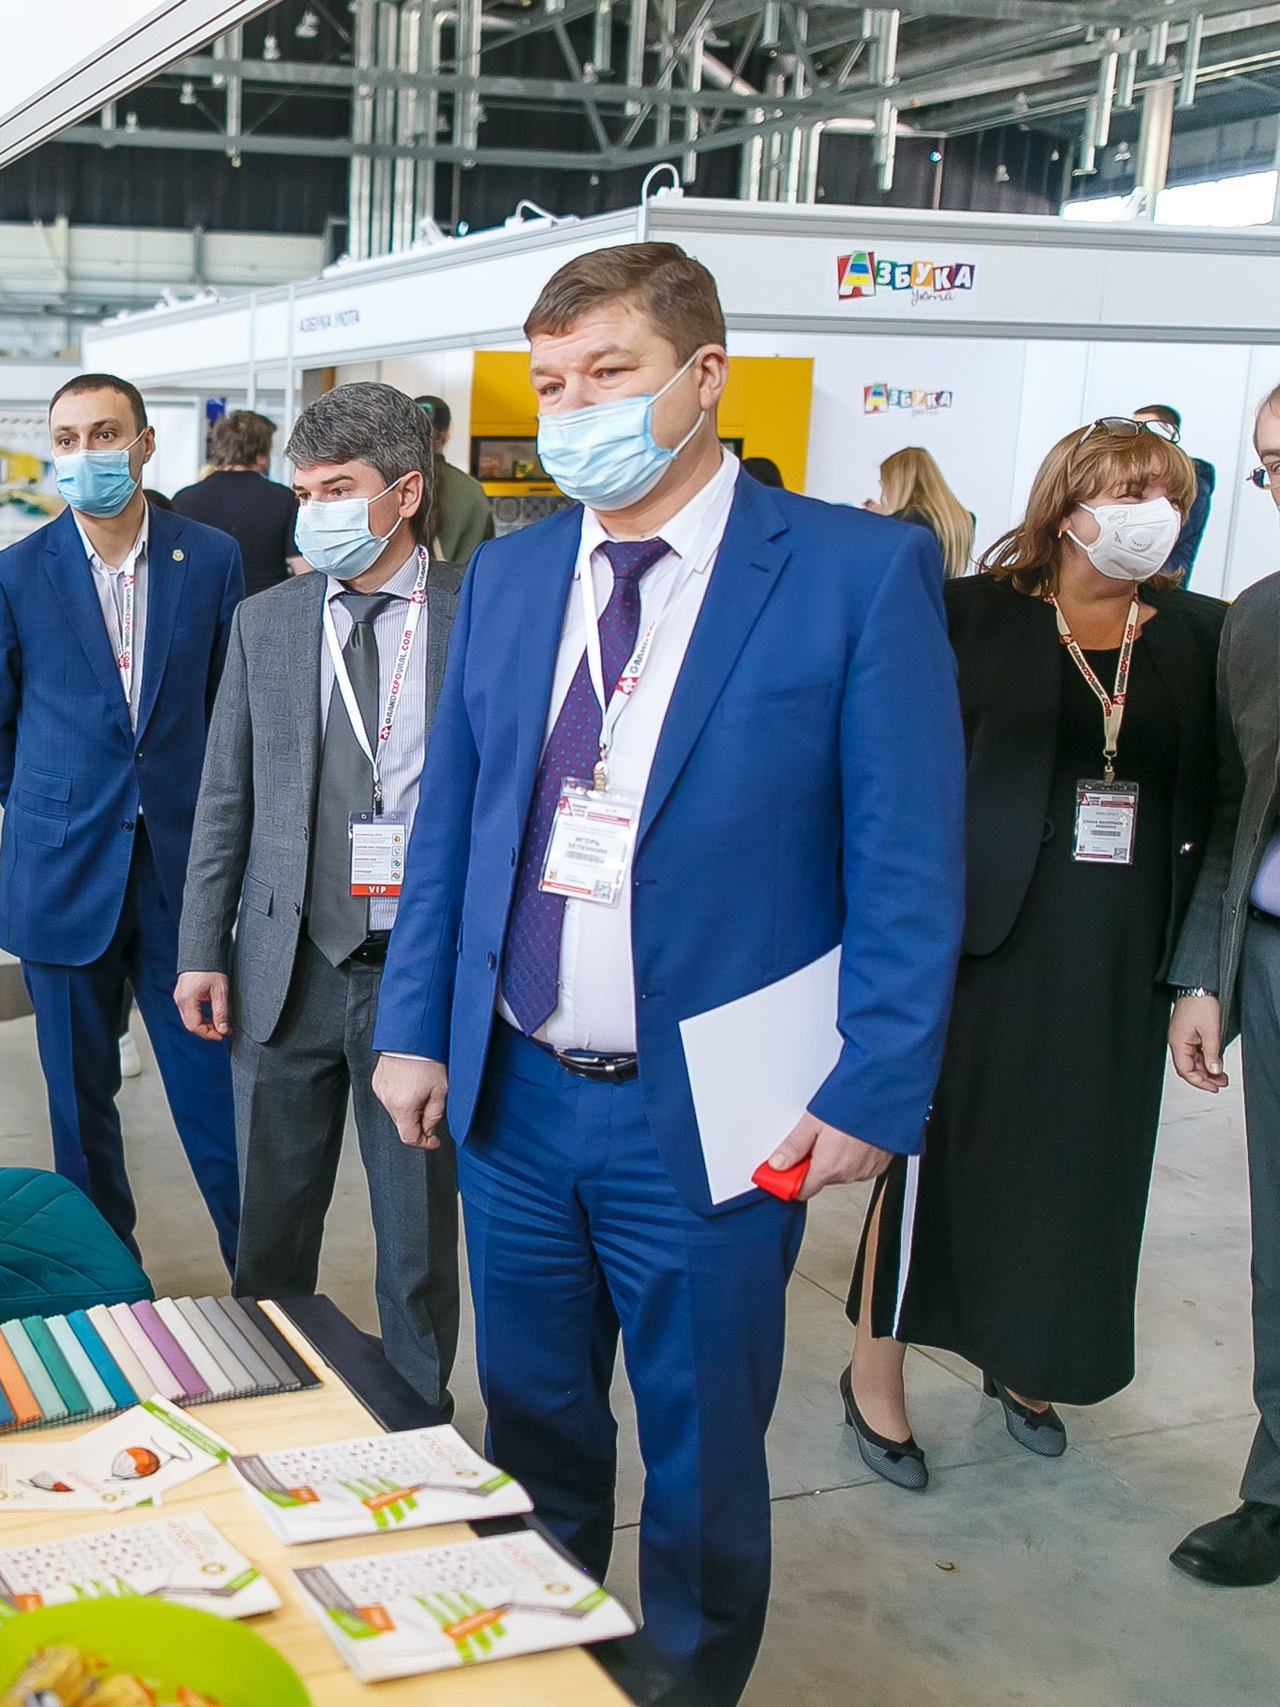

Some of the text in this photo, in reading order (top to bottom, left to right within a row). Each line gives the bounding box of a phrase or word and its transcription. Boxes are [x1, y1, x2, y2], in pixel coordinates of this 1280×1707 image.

[838, 251, 975, 300] АЗБУКА
[864, 383, 953, 414] АЗБУКА
[368, 885, 387, 894] VIP
